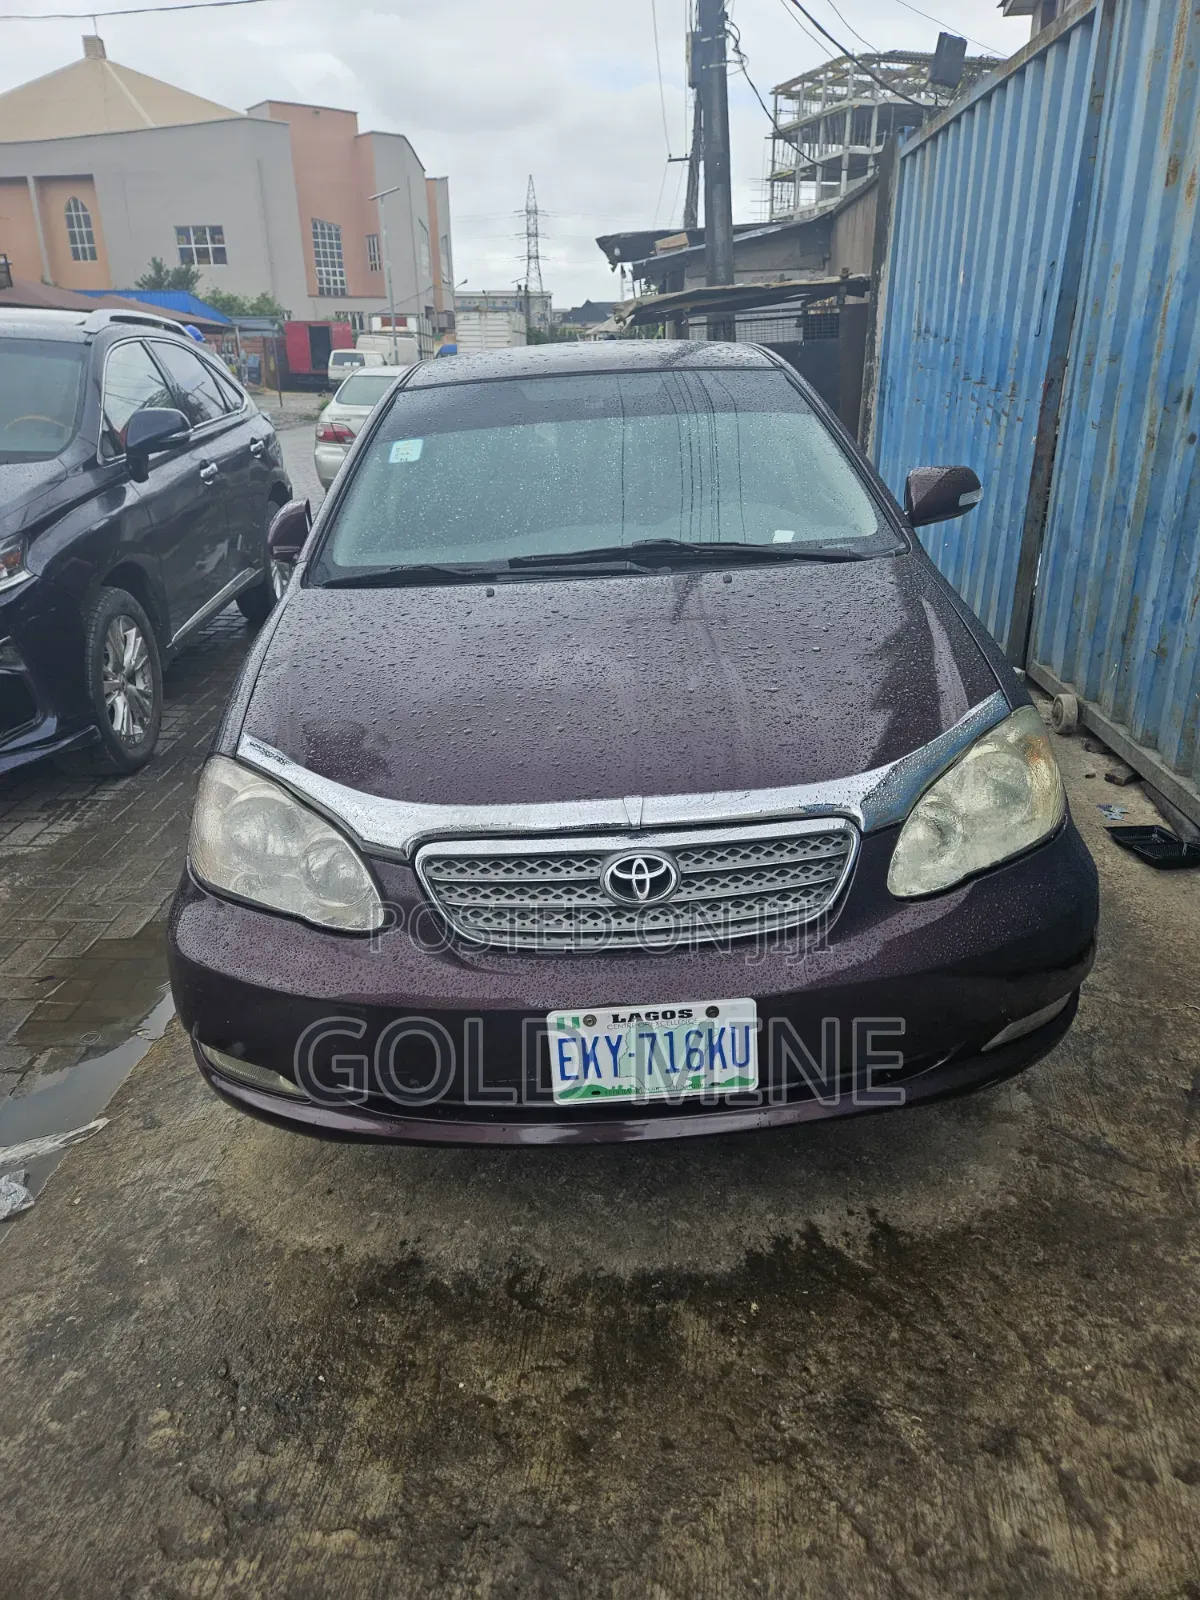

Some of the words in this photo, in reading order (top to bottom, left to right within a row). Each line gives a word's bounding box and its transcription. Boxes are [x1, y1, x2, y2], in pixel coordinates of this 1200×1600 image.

[612, 1009, 694, 1024] LAGOS
[606, 1021, 636, 1031] CENTRE
[557, 1025, 750, 1081] EKY-716KU
